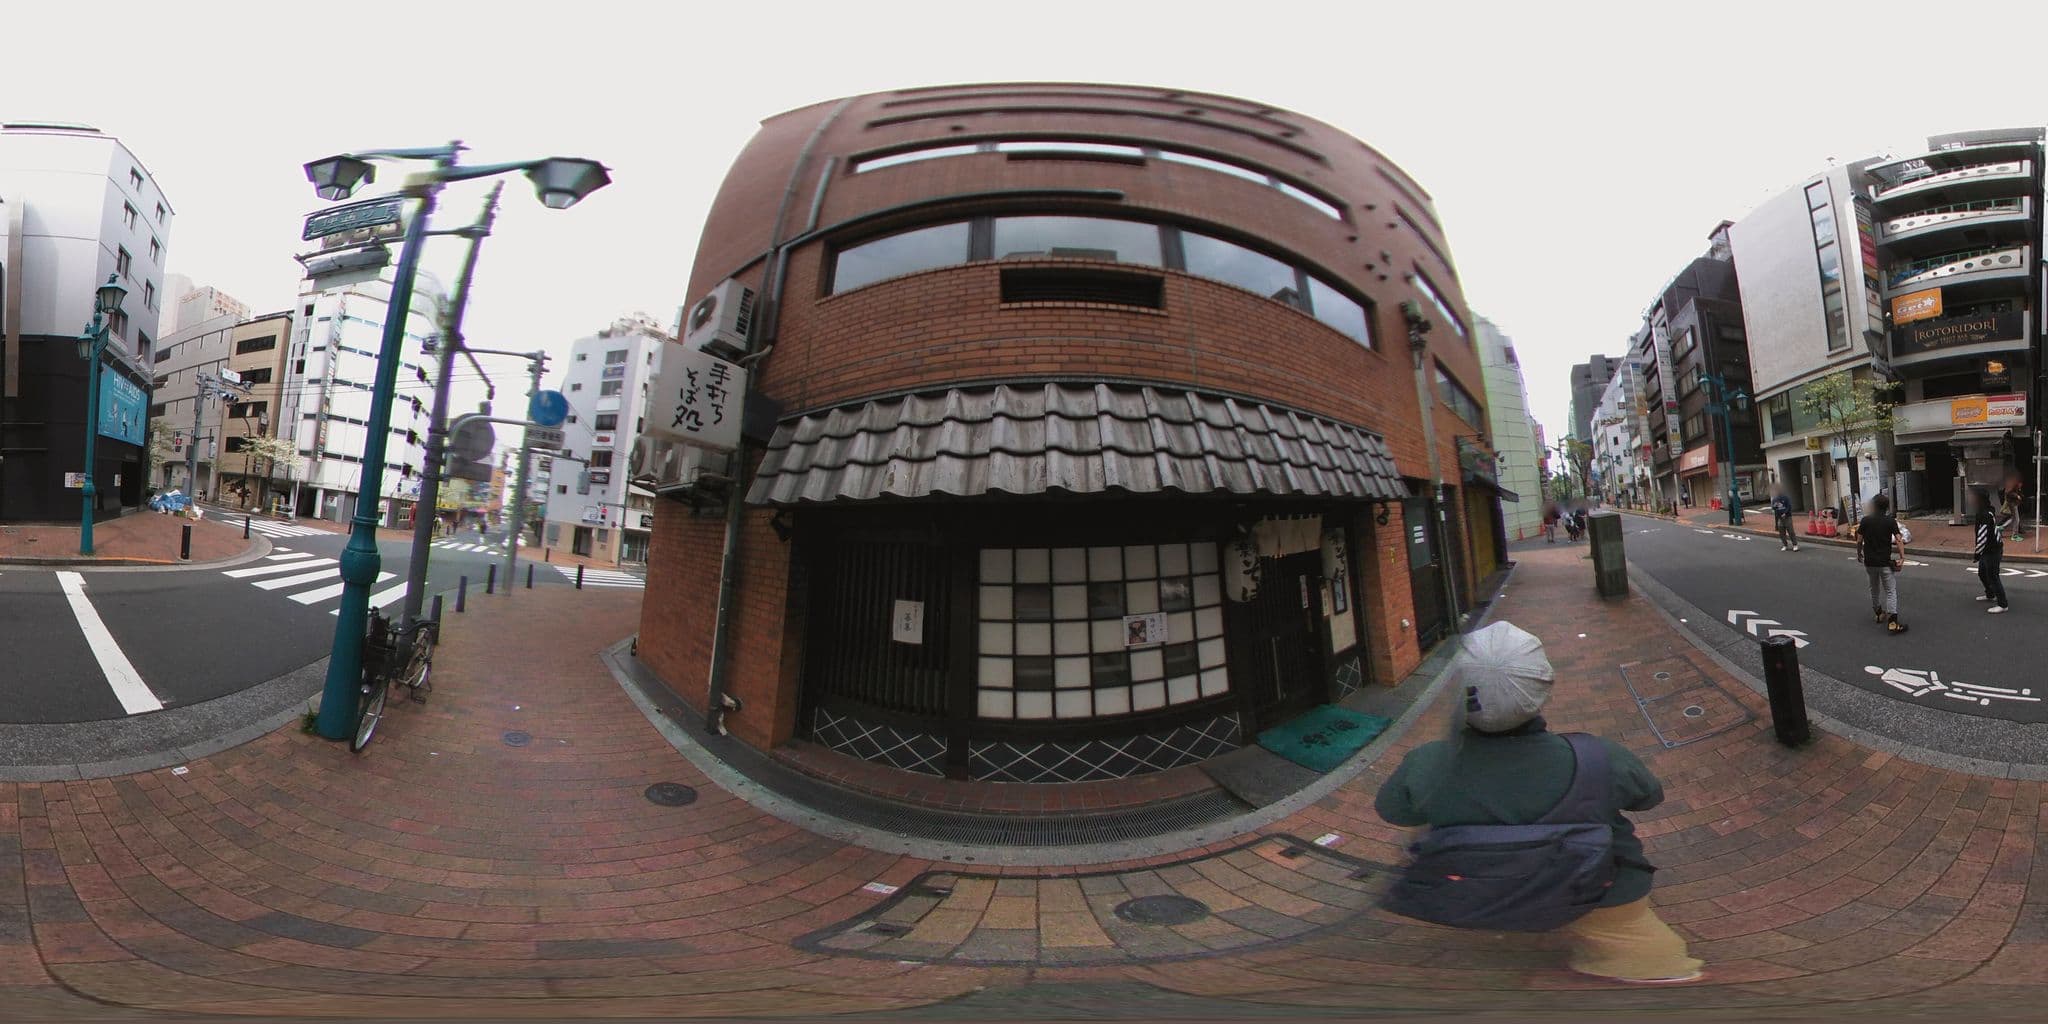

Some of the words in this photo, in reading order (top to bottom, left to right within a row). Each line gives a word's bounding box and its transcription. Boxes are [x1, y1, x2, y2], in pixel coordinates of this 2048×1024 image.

[671, 367, 704, 432] そば処
[706, 362, 731, 425] 手打ち
